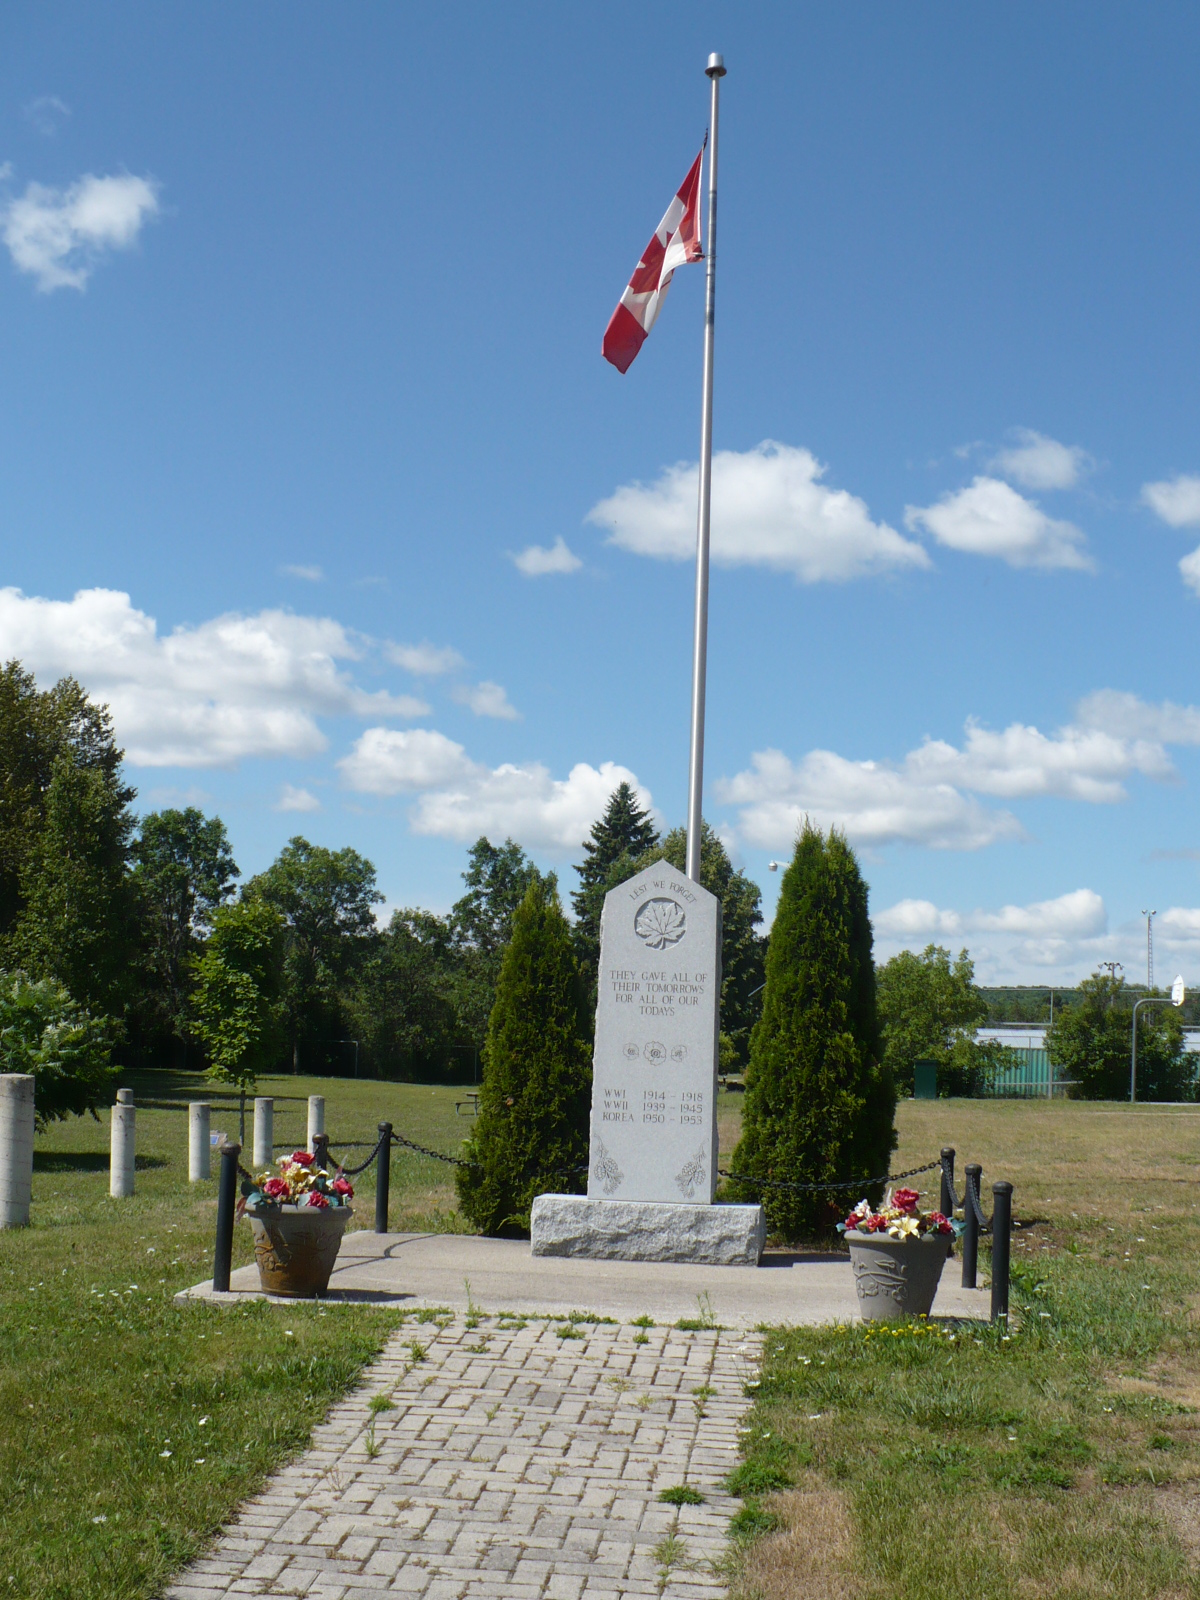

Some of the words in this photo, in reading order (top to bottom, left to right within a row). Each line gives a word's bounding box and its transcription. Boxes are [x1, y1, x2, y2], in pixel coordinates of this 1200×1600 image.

[629, 884, 648, 900] LEST
[653, 881, 666, 889] WE
[670, 882, 698, 904] FORGET
[610, 970, 636, 980] THEY
[642, 971, 666, 981] GAVE
[672, 972, 690, 982] ALL
[695, 972, 708, 982] OF
[612, 982, 640, 992] THEIR
[646, 982, 704, 994] TOMORROWS
[615, 994, 634, 1003] FOR
[640, 995, 658, 1004] ALL
[662, 996, 674, 1004] OF
[678, 996, 699, 1006] OUR
[639, 1006, 675, 1017] TODAYS
[604, 1089, 626, 1098] WWI
[643, 1090, 666, 1100] 1914
[682, 1092, 703, 1102] 1918
[604, 1101, 628, 1110] WWII
[642, 1102, 666, 1112] 1939
[680, 1104, 703, 1114] 1945
[602, 1112, 634, 1122] KOREA
[642, 1114, 665, 1124] 1950
[680, 1116, 702, 1125] 1953
